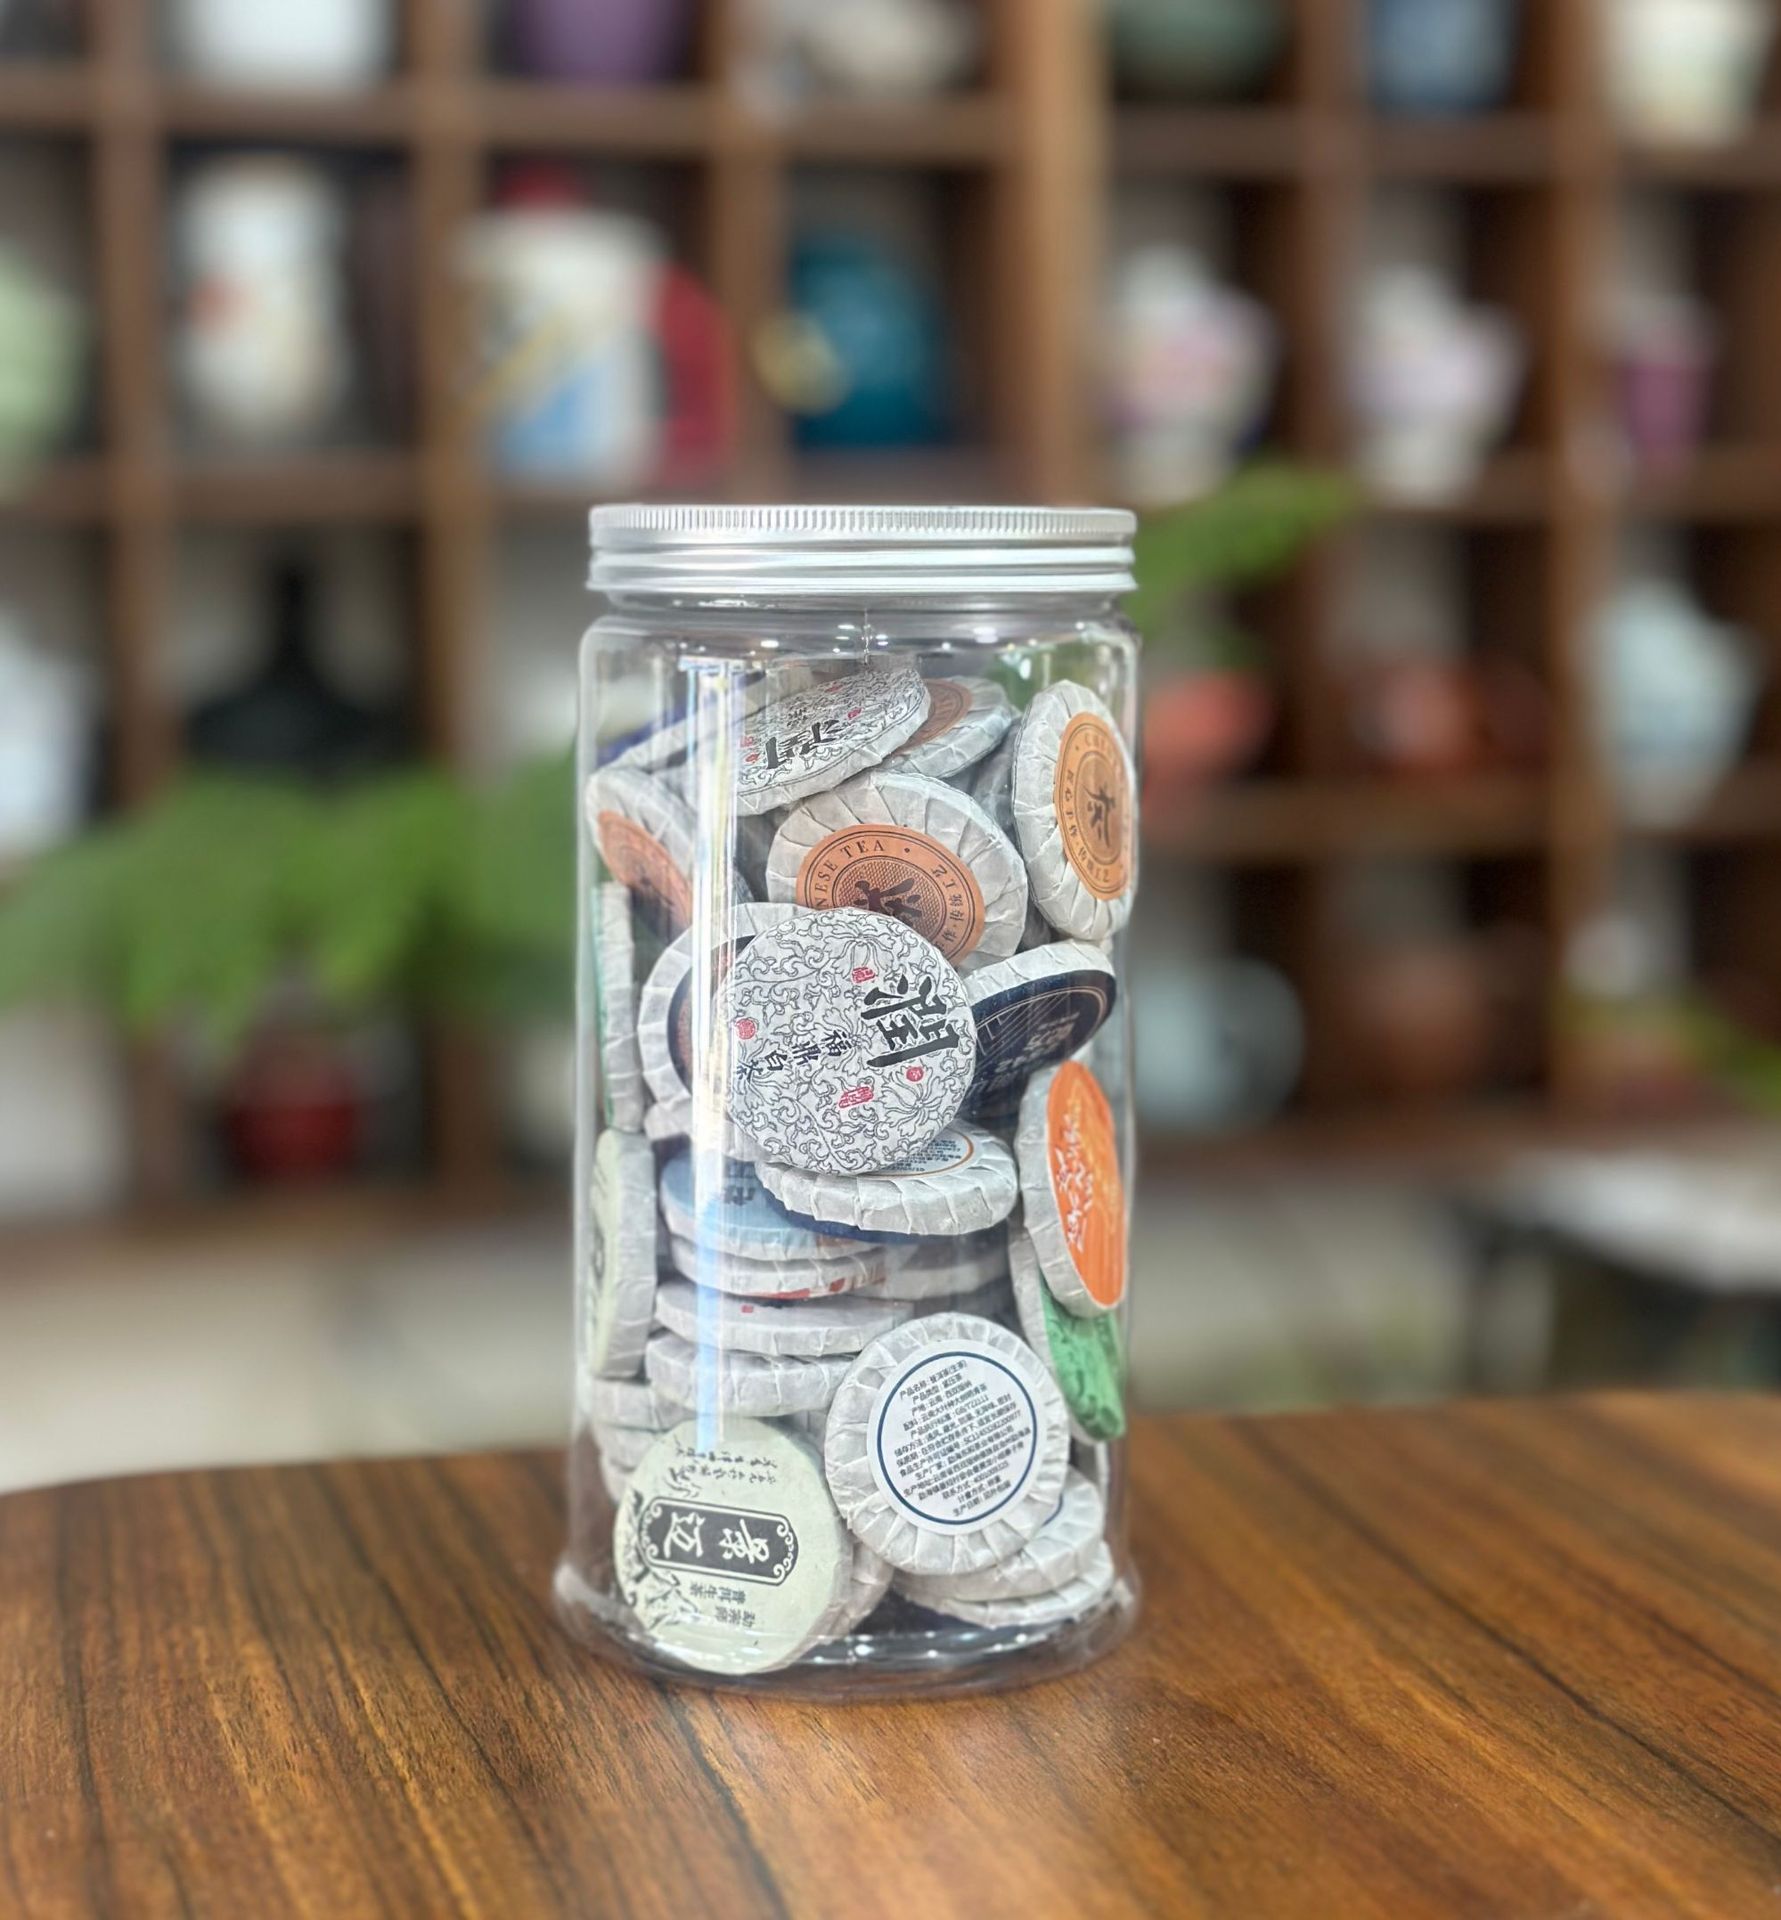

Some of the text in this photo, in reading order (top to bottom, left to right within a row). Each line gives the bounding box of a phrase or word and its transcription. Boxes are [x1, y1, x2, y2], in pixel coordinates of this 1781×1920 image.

[815, 839, 886, 908] NESE TEA
[736, 1029, 852, 1081] 福鼎白茶
[860, 974, 960, 1068] 潤
